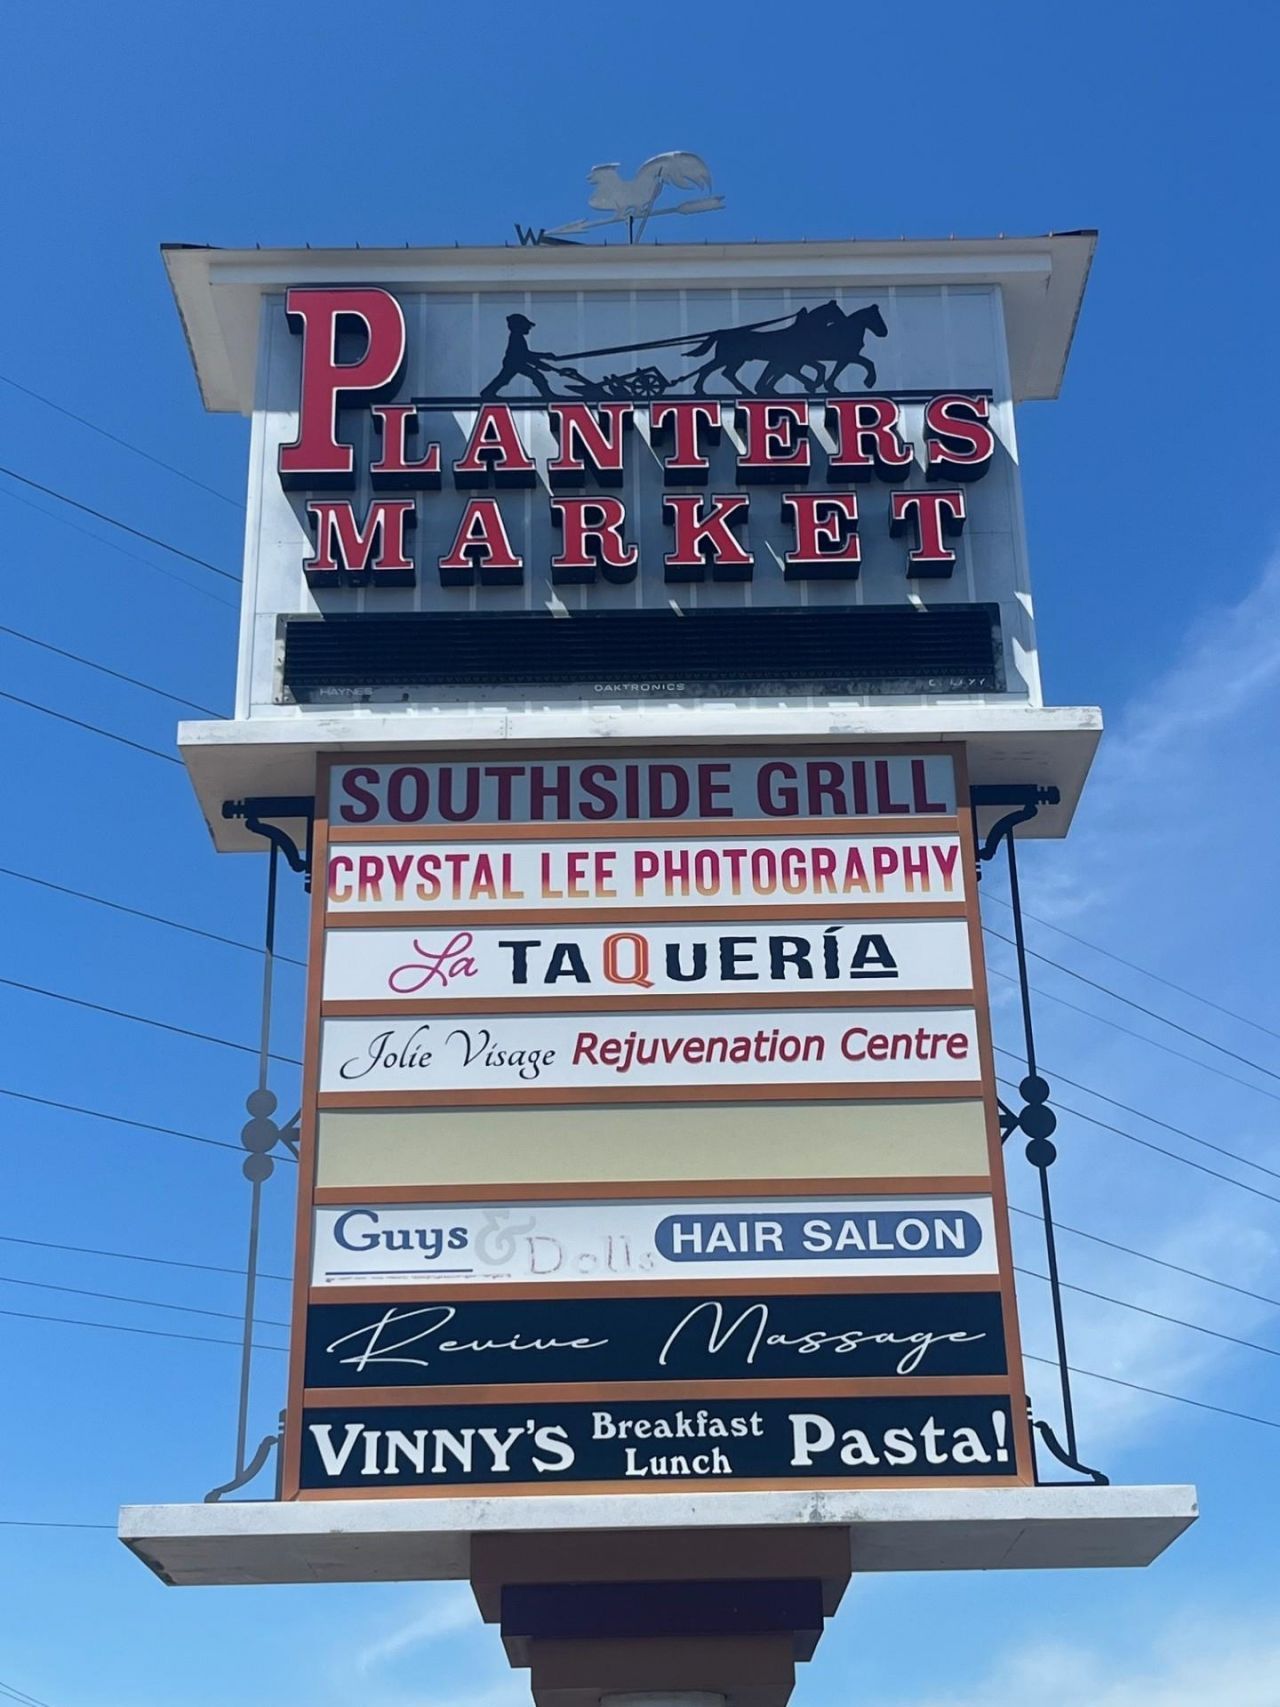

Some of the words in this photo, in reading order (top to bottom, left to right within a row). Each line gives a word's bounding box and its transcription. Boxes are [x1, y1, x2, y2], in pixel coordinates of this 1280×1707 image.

[279, 286, 996, 490] PLANTERS
[303, 490, 967, 587] MARKET
[340, 764, 734, 823] SOUTHSIDE
[757, 760, 947, 817] GRILL
[328, 853, 524, 903] CRYSTAL
[541, 851, 617, 899] LEE
[634, 845, 960, 897] PHOTOGRAPHY
[388, 932, 478, 994] La
[498, 926, 899, 990] TAQUERÍA
[339, 1024, 433, 1080] Jolie
[445, 1029, 556, 1080] Visage
[572, 1029, 825, 1073] Rejuvenation
[841, 1027, 969, 1062] Centre
[333, 1209, 469, 1260] Guys
[672, 1220, 784, 1254] HAIR
[802, 1217, 966, 1251] SALON
[326, 1306, 609, 1373] Revive
[659, 1301, 987, 1375] Massage
[309, 1418, 576, 1476] VINNY'S
[592, 1410, 765, 1440] Breakfast
[788, 1410, 1010, 1467] Pasta!
[625, 1447, 733, 1477] Lunch
